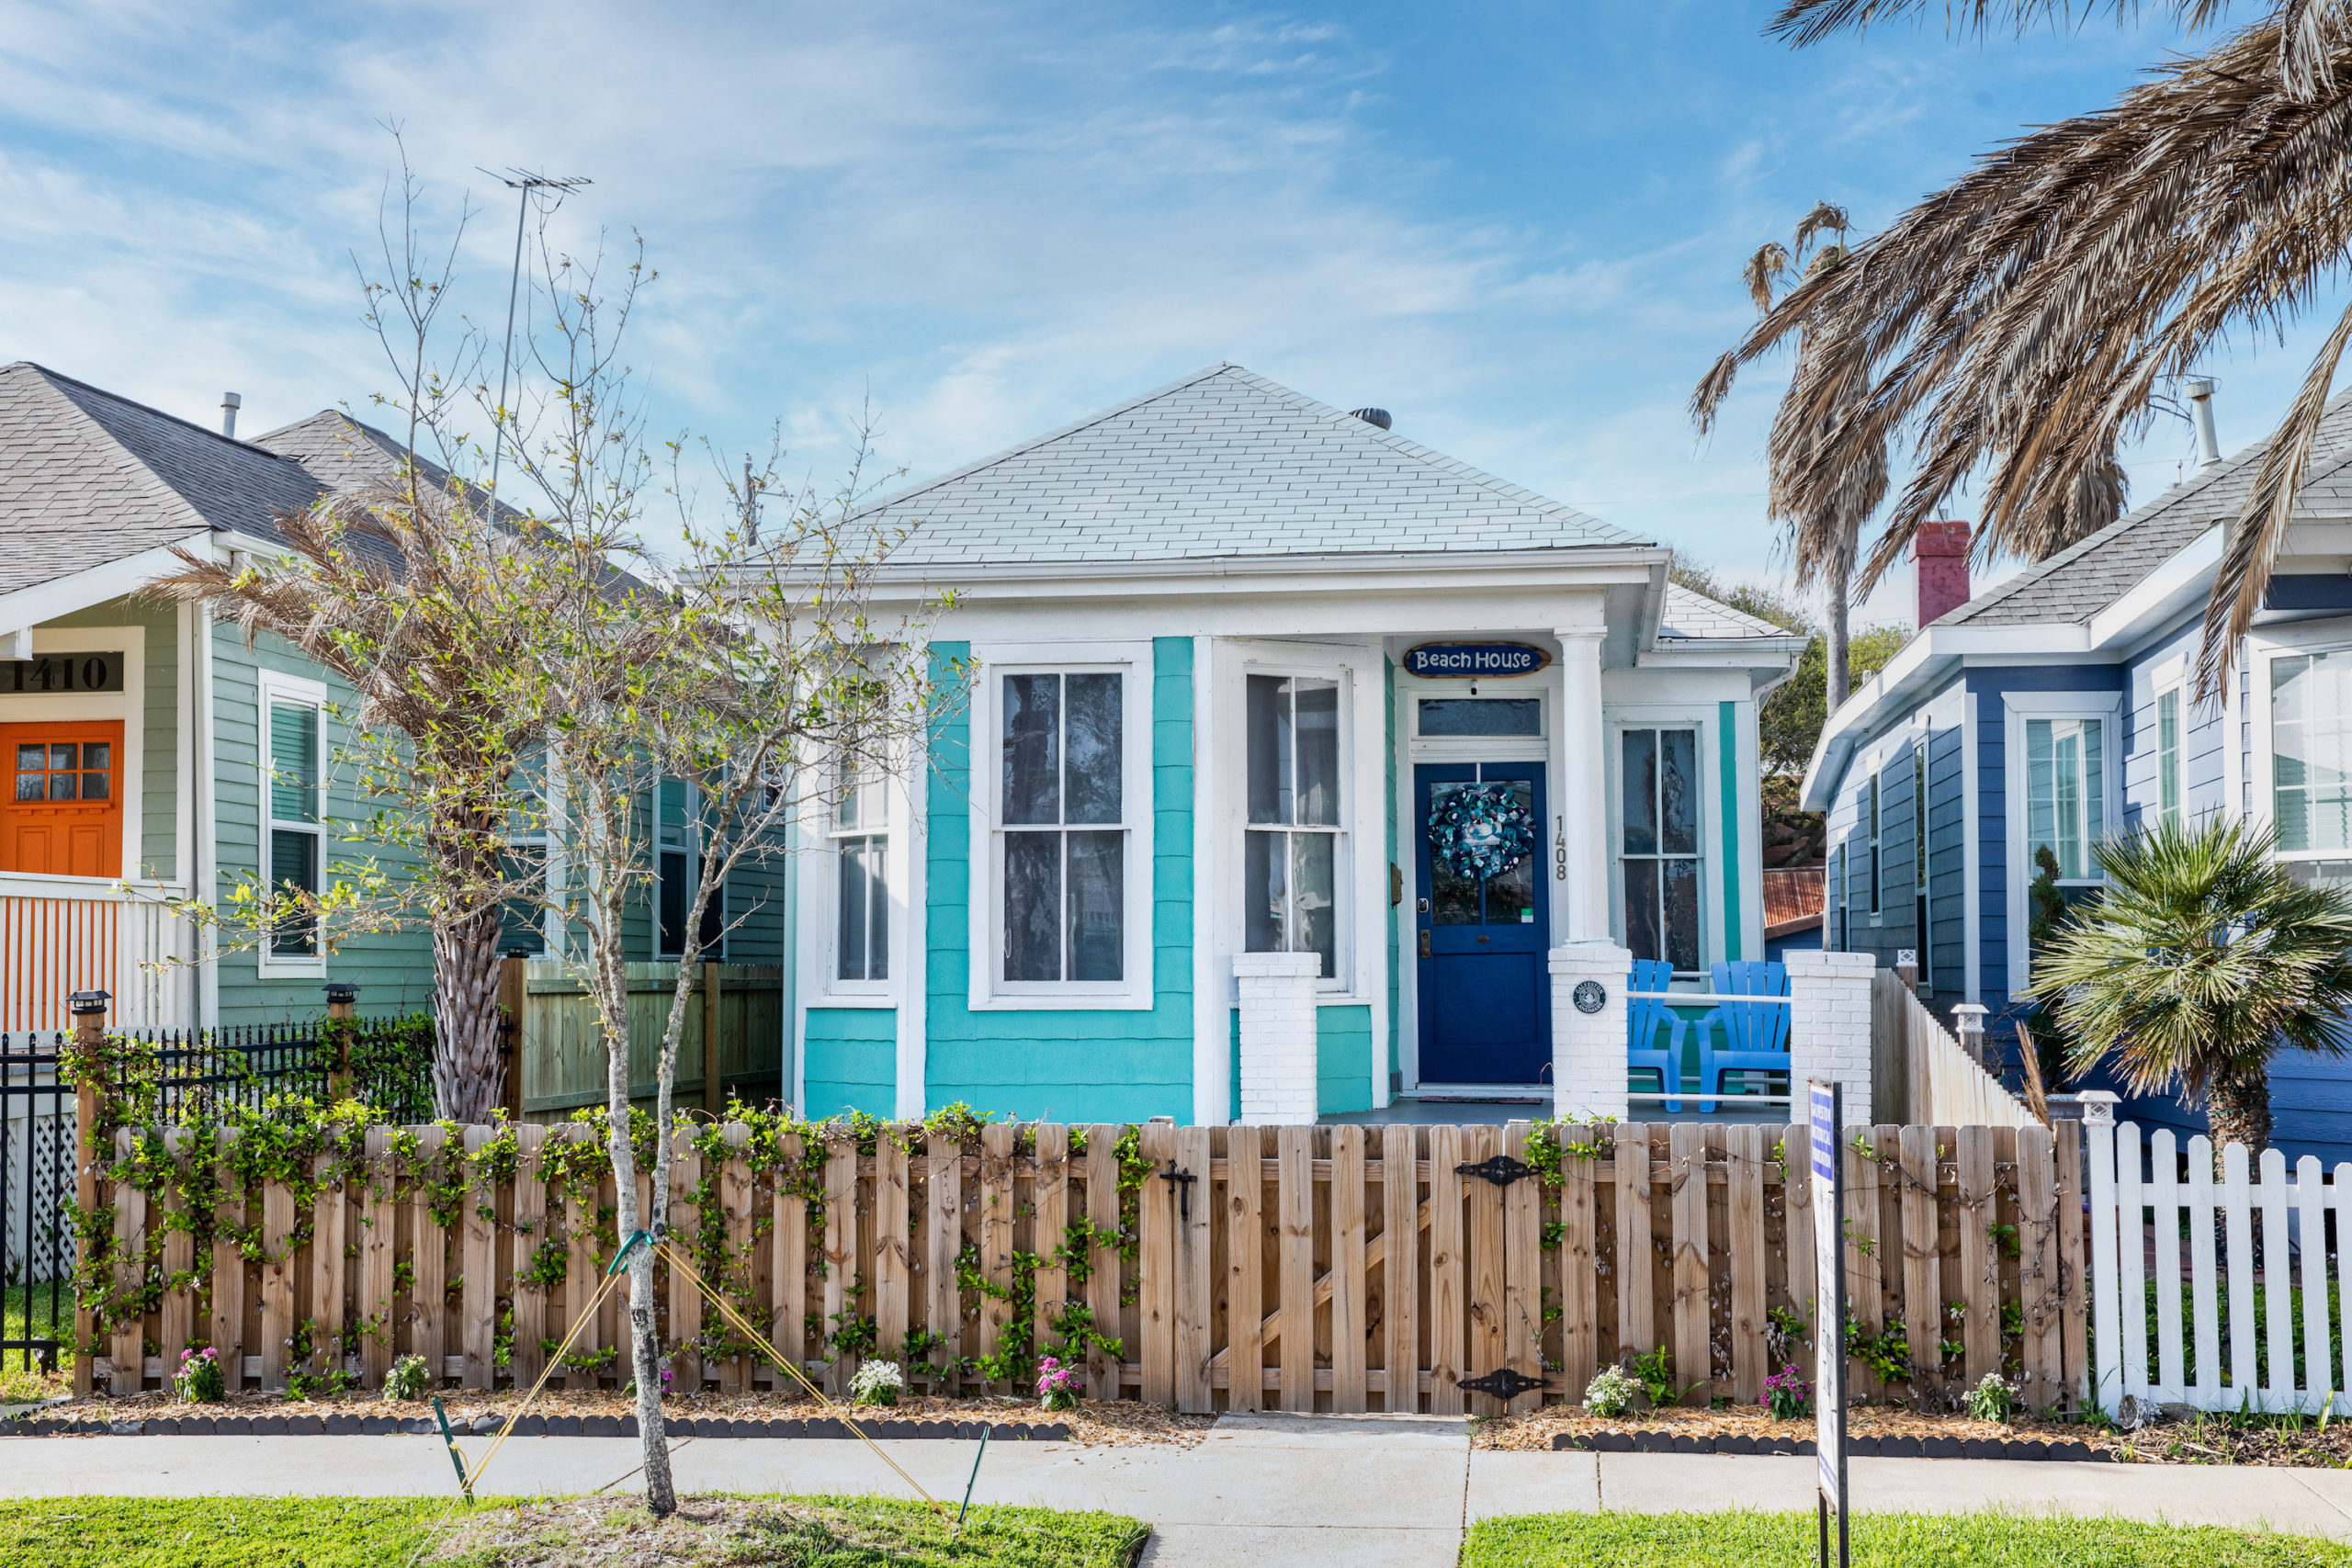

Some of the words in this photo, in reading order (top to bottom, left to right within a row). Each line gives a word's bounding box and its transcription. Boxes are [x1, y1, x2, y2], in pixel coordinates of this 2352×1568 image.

[1415, 651, 1471, 670] Beach
[1475, 652, 1531, 669] House
[12, 658, 107, 691] 1410
[1555, 815, 1566, 881] 1408
[1575, 981, 1604, 994] GALVESTON
[1575, 1000, 1604, 1012] LANDMARK
